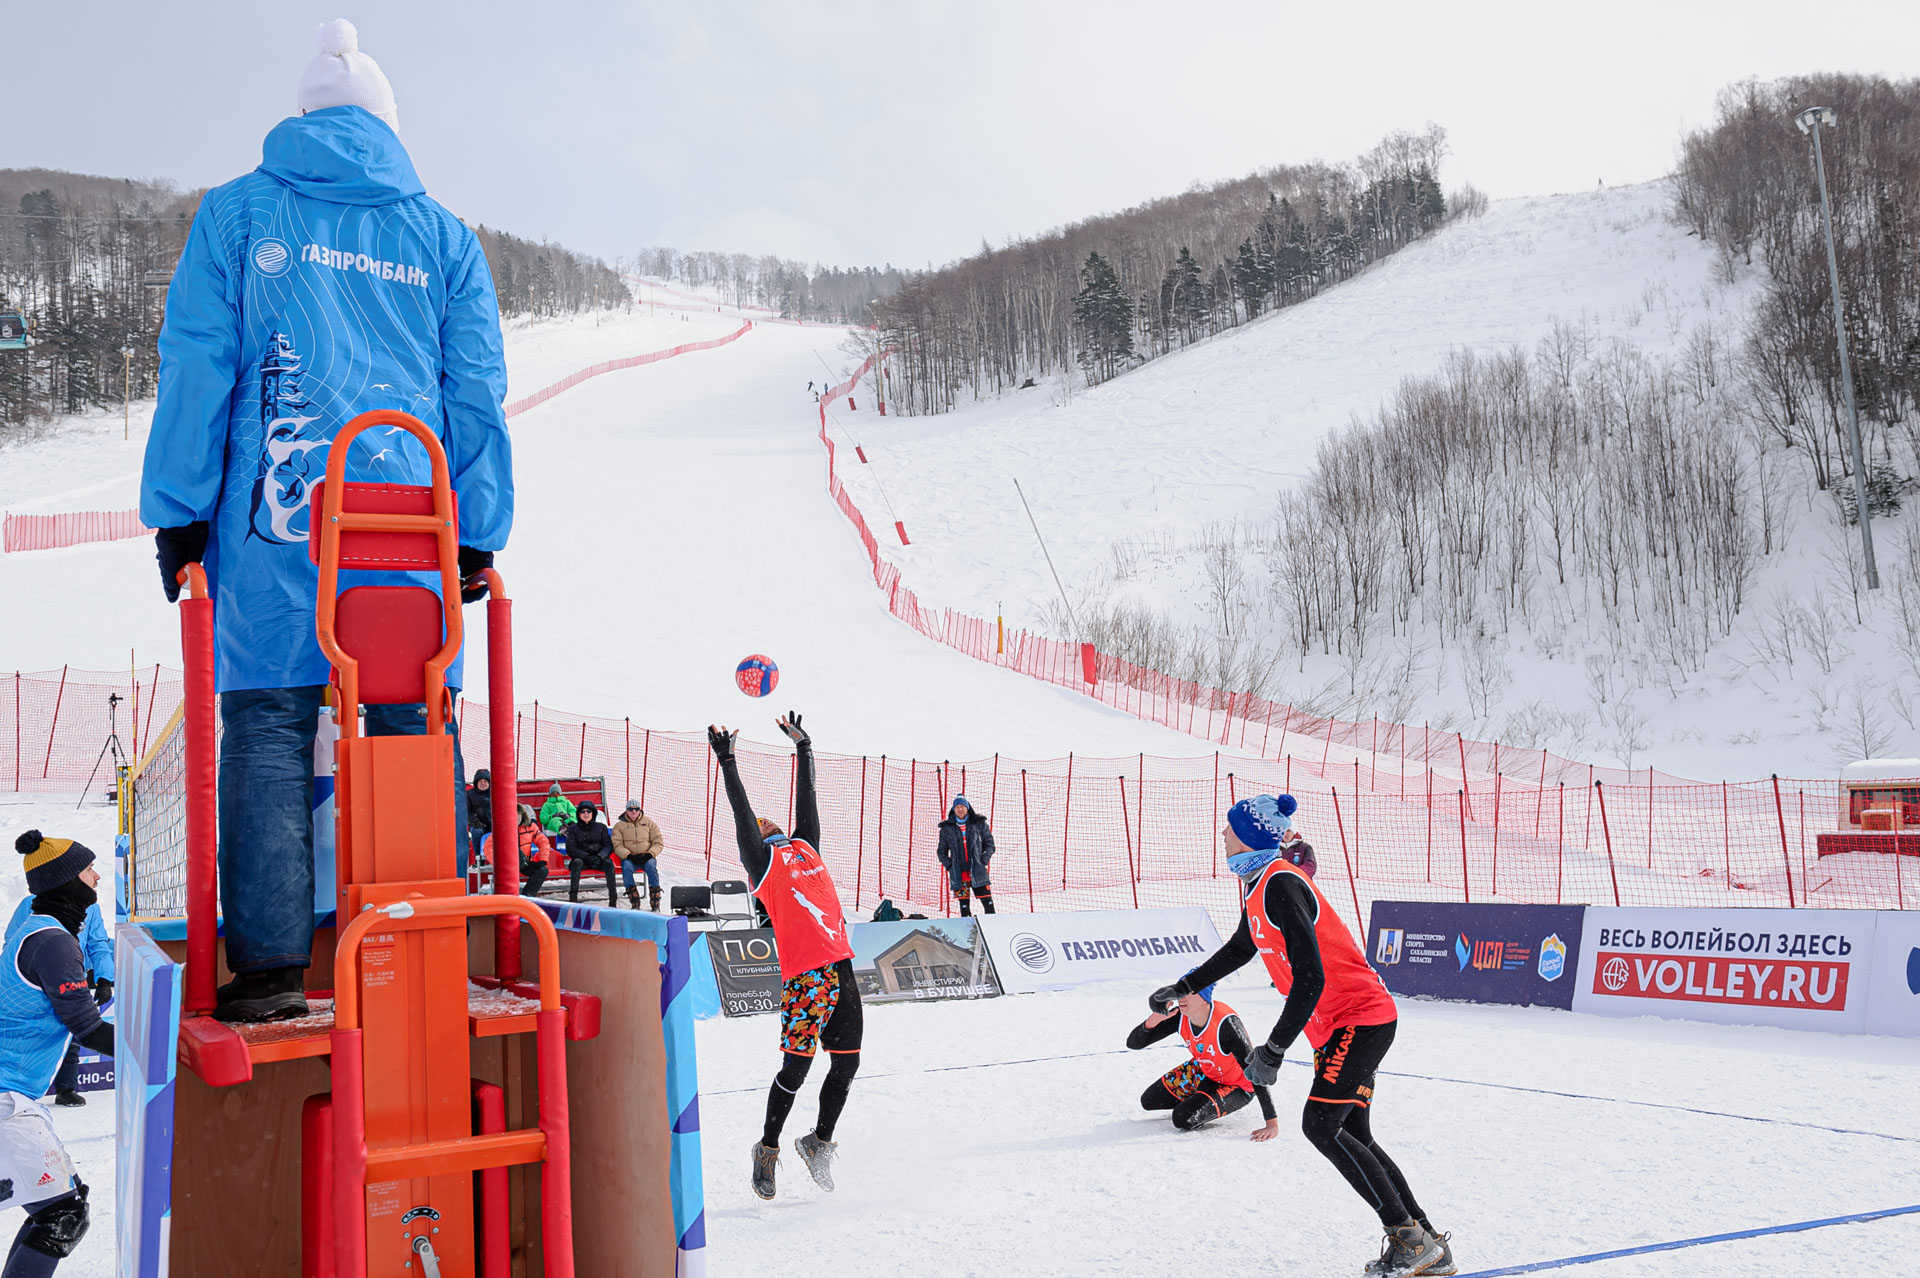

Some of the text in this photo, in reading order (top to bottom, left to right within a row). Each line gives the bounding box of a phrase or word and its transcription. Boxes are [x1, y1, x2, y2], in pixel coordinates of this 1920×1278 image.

[301, 243, 430, 288] ГАЗПРОМБАНК
[1061, 934, 1206, 961] ГАЗПРОМБАНК
[1599, 927, 1852, 958] ВЕСЬ ВОЛЕЙБОЛ ЗДЕСЬ
[1472, 941, 1504, 971] ЦСП
[736, 965, 773, 974] КЛУБНЫЙ
[912, 976, 965, 988] ИНВЕСТИРУЙ
[1634, 958, 1838, 1005] VOLLEY.RU
[726, 989, 772, 999] поле65.рф
[913, 983, 994, 999] В БУДУЩЕЕ
[729, 998, 782, 1013] 30-30-
[1206, 1044, 1216, 1057] 4
